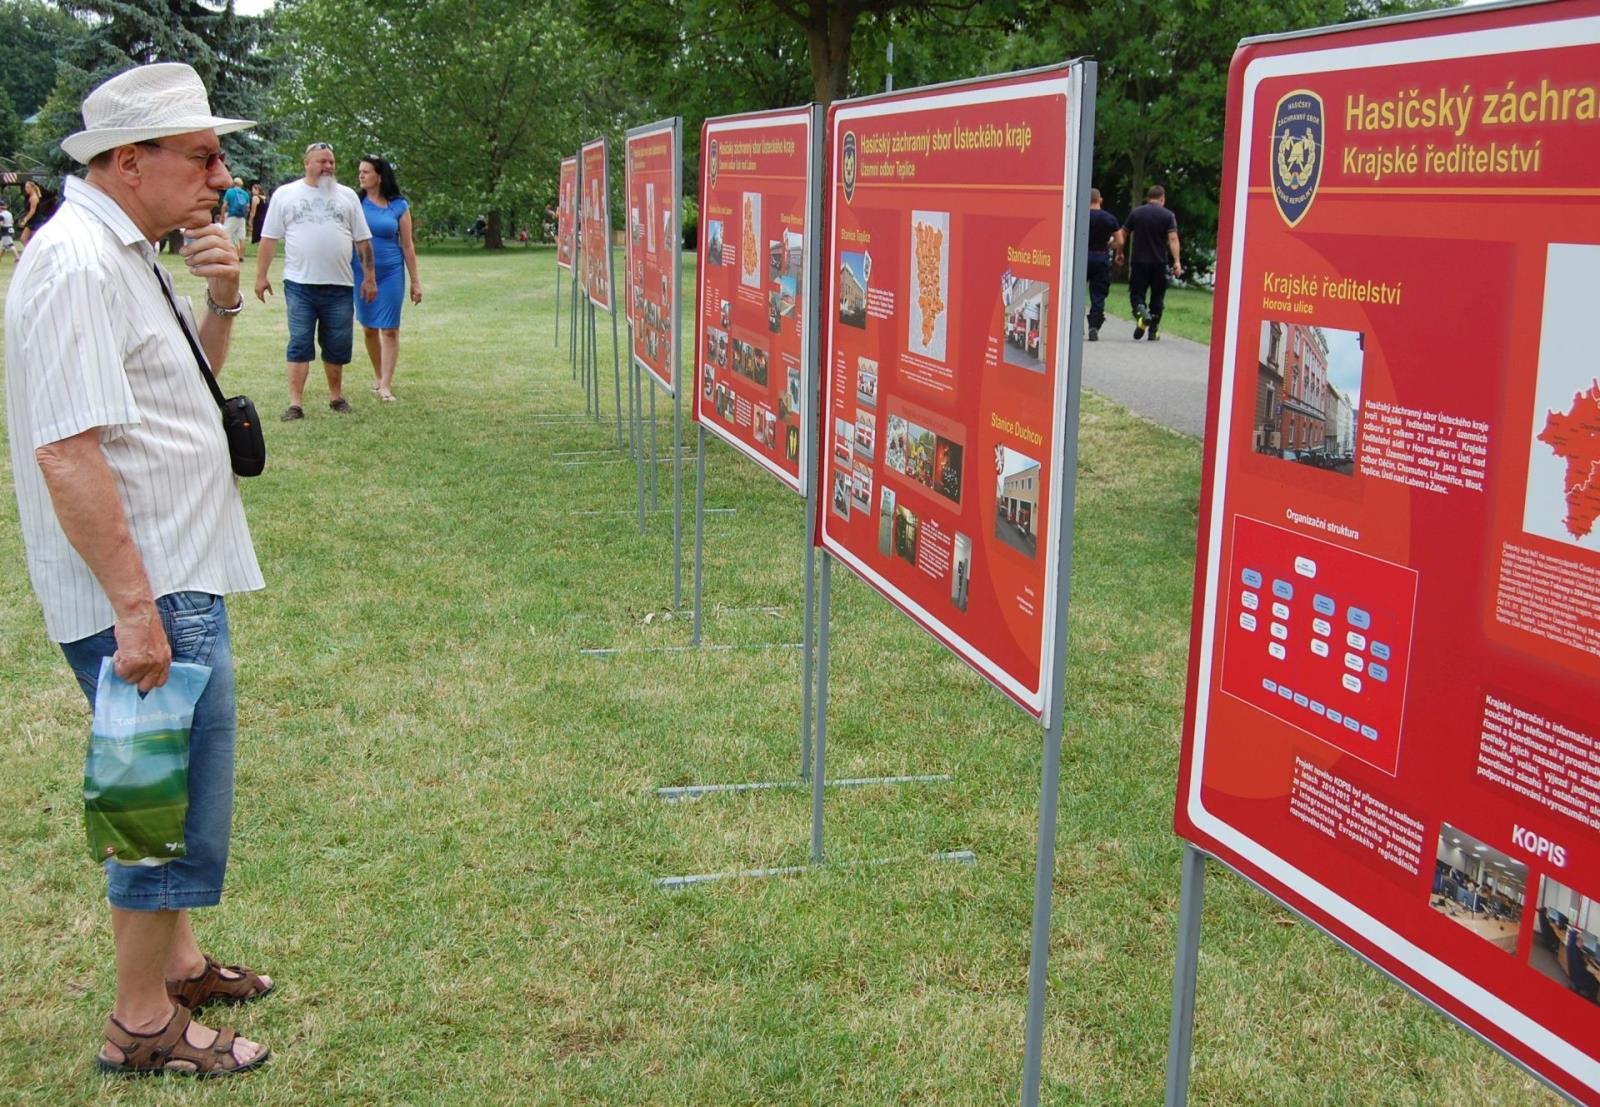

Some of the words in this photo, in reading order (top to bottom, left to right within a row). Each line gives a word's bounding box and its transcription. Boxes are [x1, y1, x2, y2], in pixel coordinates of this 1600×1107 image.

[1346, 84, 1473, 136] Hasičský
[1482, 79, 1600, 124] záchra
[892, 128, 931, 157] záchranný
[932, 128, 952, 151] sbor
[954, 120, 1003, 149] Ústeckého
[1005, 121, 1031, 153] kraje
[1343, 145, 1417, 181] Krajské
[1425, 140, 1541, 174] ředitelství
[1008, 246, 1031, 264] Stanice
[1264, 271, 1317, 299] Krajské
[1322, 276, 1402, 305] ředitelství
[1263, 298, 1292, 312] Horova
[1293, 301, 1313, 314] ulice
[992, 412, 1014, 434] Stanice
[1440, 427, 1444, 435] a
[1448, 427, 1453, 436] 7
[1472, 420, 1489, 433] kraje
[1286, 508, 1326, 529] Organizační
[1327, 522, 1359, 540] struktura
[1545, 721, 1551, 729] a
[1559, 752, 1564, 761] a
[1346, 817, 1383, 843] operačního
[1386, 840, 1420, 865] programu
[1512, 824, 1566, 867] KOPIS
